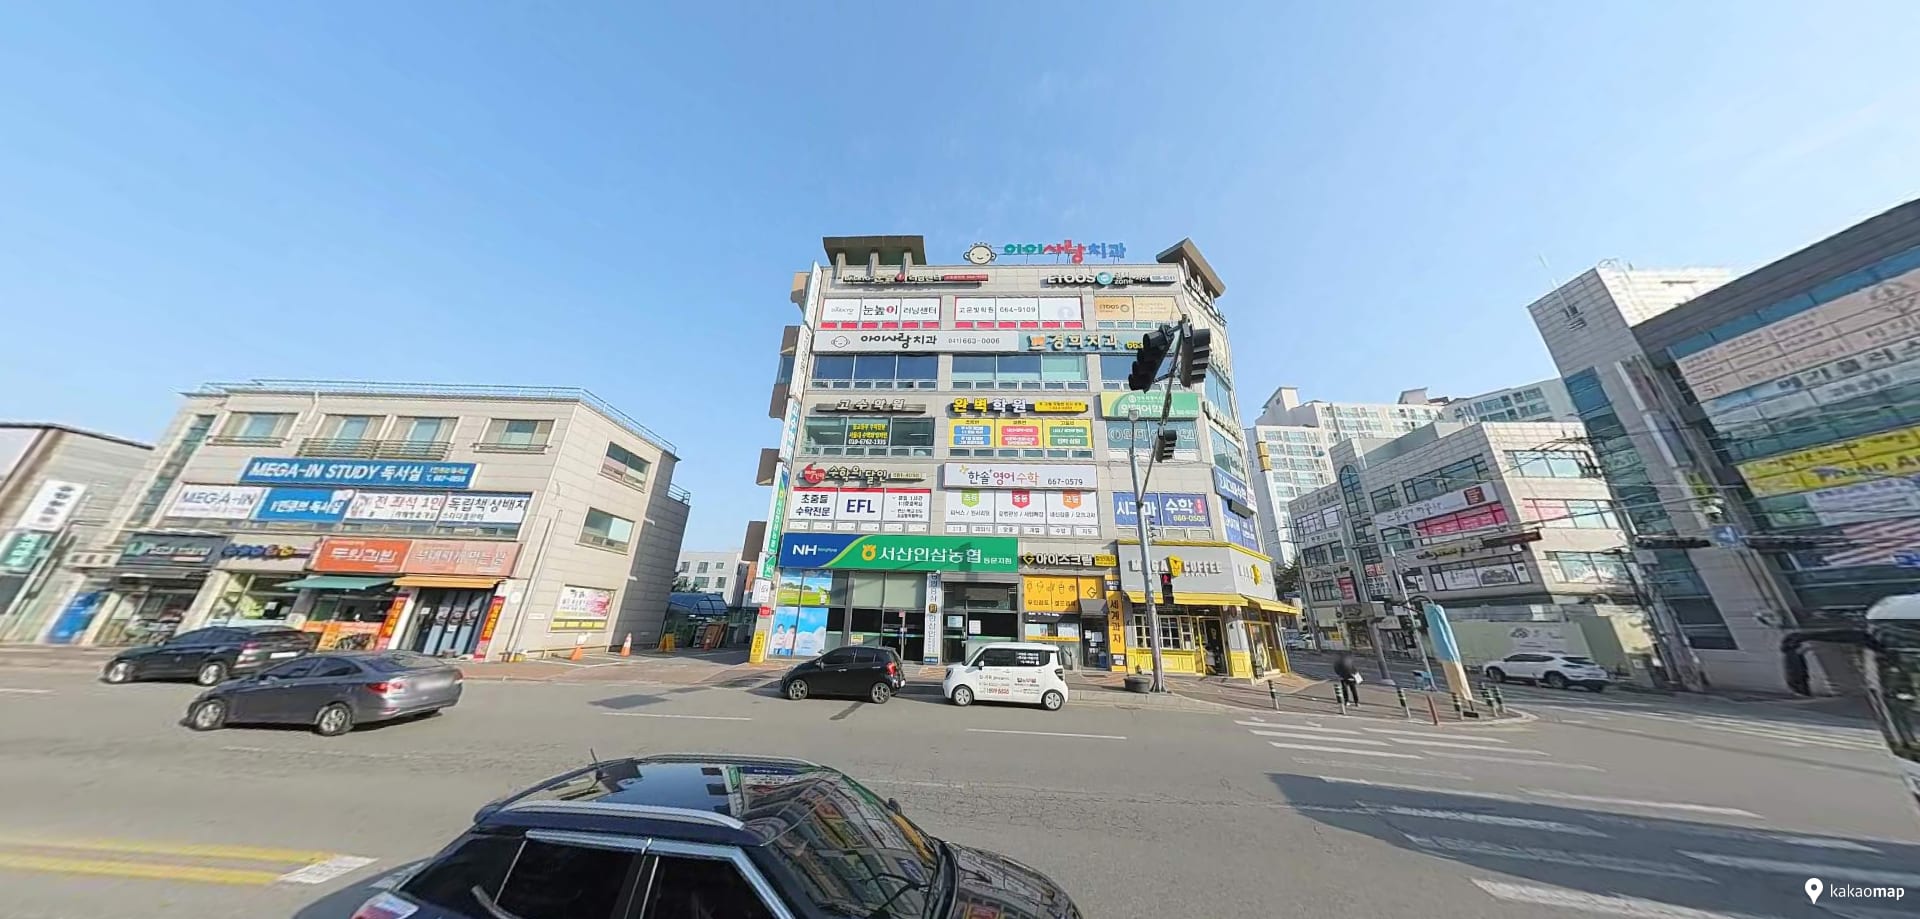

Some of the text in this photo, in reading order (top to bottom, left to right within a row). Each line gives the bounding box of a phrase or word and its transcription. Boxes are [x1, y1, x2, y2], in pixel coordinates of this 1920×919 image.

[1004, 240, 1126, 264] 아이사랑치과
[1046, 273, 1096, 284] ETOOS
[903, 306, 937, 315] 러닝센터
[861, 333, 938, 348] 아이사랑치과
[953, 397, 1027, 414] 완벽학원
[249, 461, 321, 479] MEGA-IN
[326, 463, 377, 480] STUDY
[380, 464, 424, 481] 독서실
[827, 464, 863, 482] 수학의
[864, 468, 888, 485] 달인
[968, 471, 1083, 485] 한솔 영어 수학 667-0579
[374, 496, 388, 509] 전
[391, 497, 416, 510] 좌석
[846, 499, 876, 514] EFL
[1165, 497, 1193, 514] 수학
[796, 506, 831, 517] 수학전문
[792, 544, 818, 556] NH
[878, 547, 982, 563] 서산인삼농협
[1036, 552, 1093, 567] 아이스크림
[1131, 559, 1169, 572] MGA
[1183, 560, 1223, 574] COFFEE
[1110, 599, 1121, 644] 세계과자
